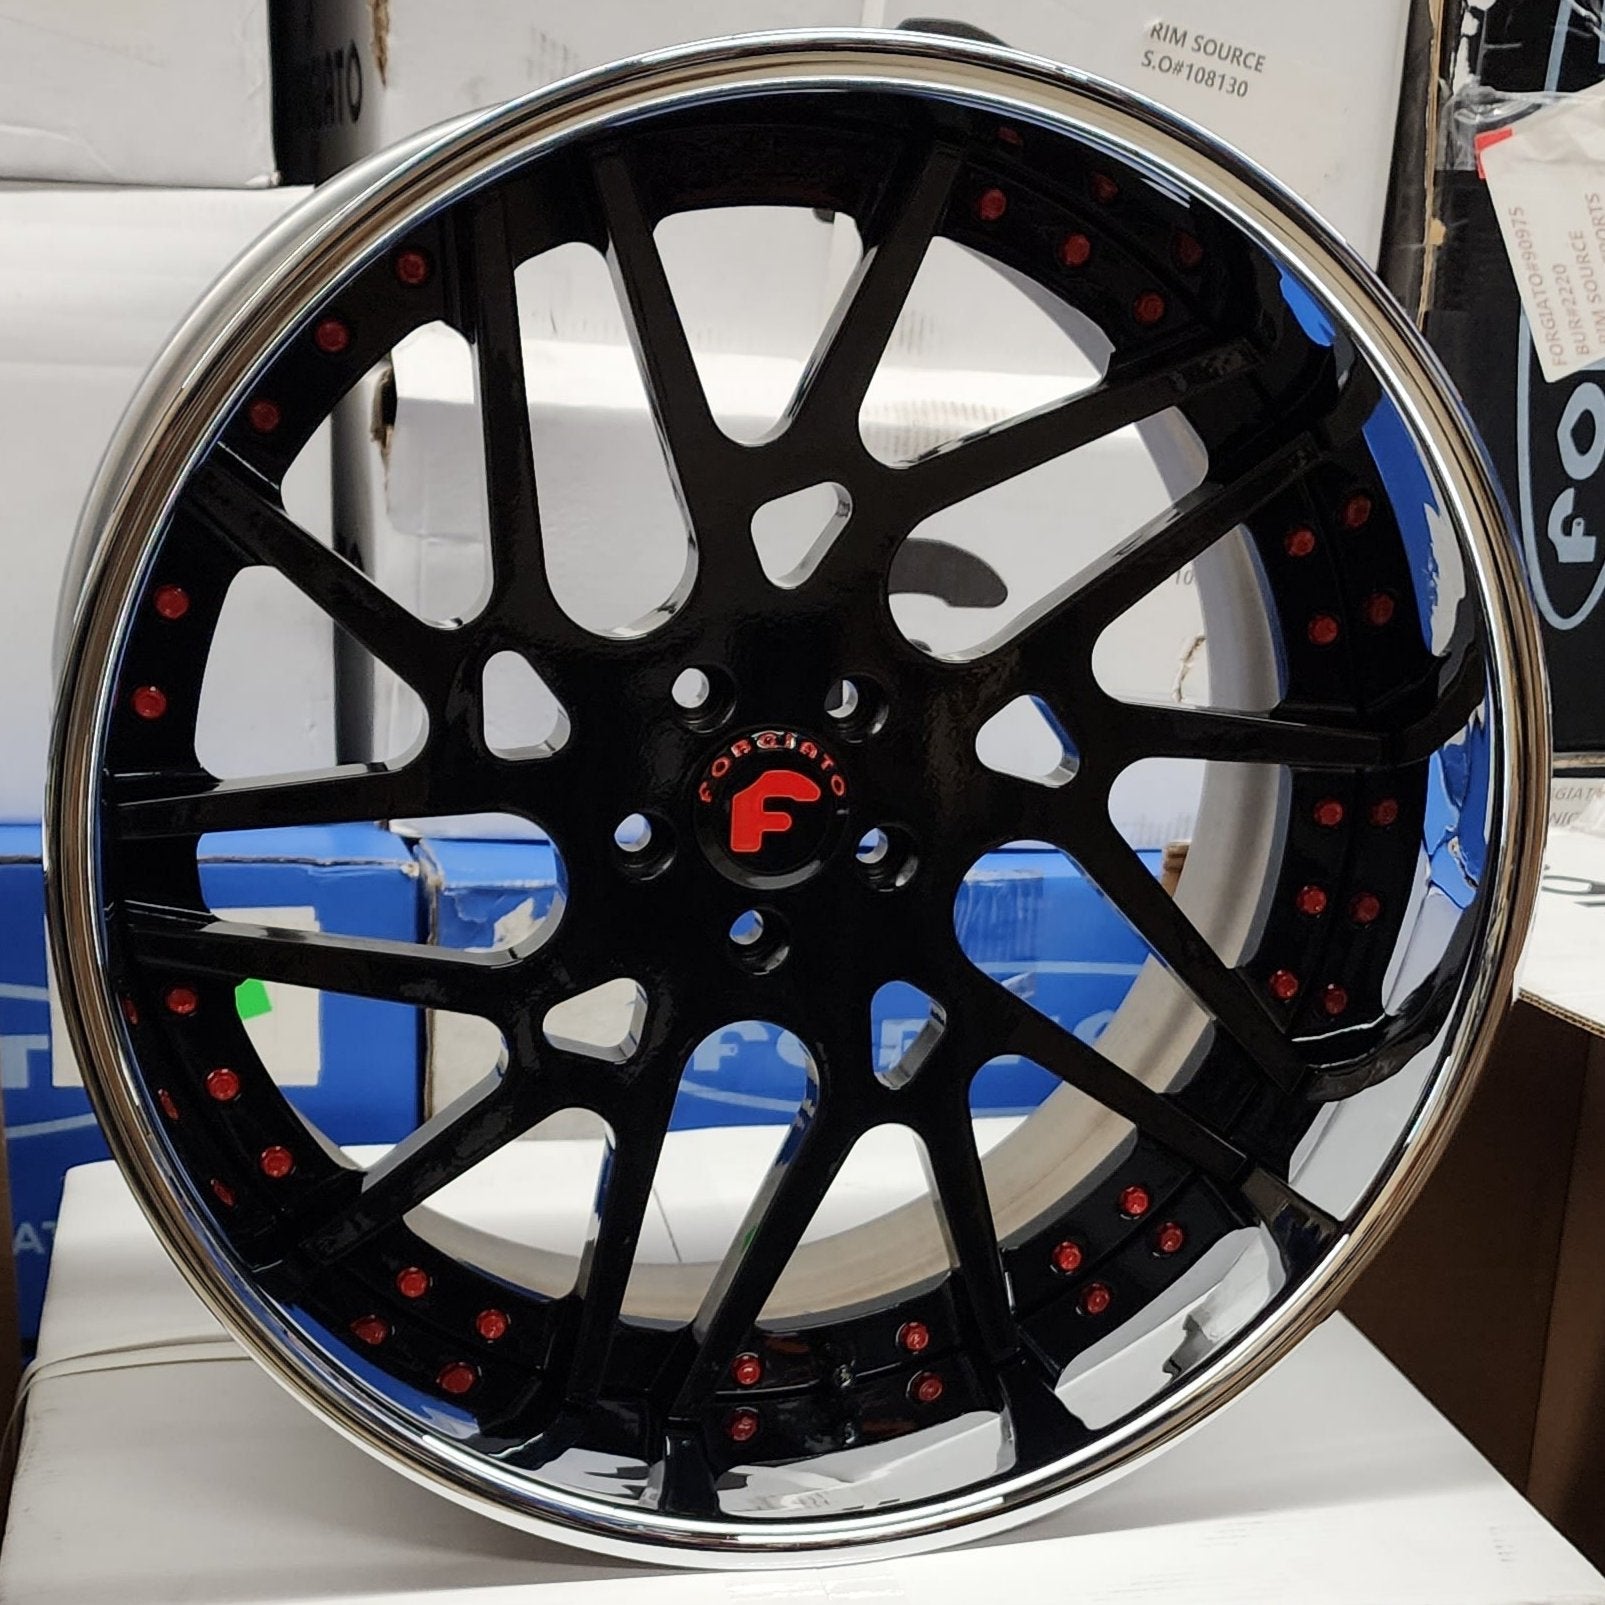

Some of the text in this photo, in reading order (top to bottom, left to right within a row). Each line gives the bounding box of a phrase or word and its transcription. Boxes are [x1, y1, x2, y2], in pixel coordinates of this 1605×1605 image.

[1141, 49, 1248, 97] S.O#108130
[1150, 22, 1266, 73] RIM SOURCE
[1508, 206, 1567, 367] FORGIATO#90975
[1569, 230, 1602, 304] SOURCE
[699, 731, 845, 803] FORGIATO
[731, 770, 821, 853] F
